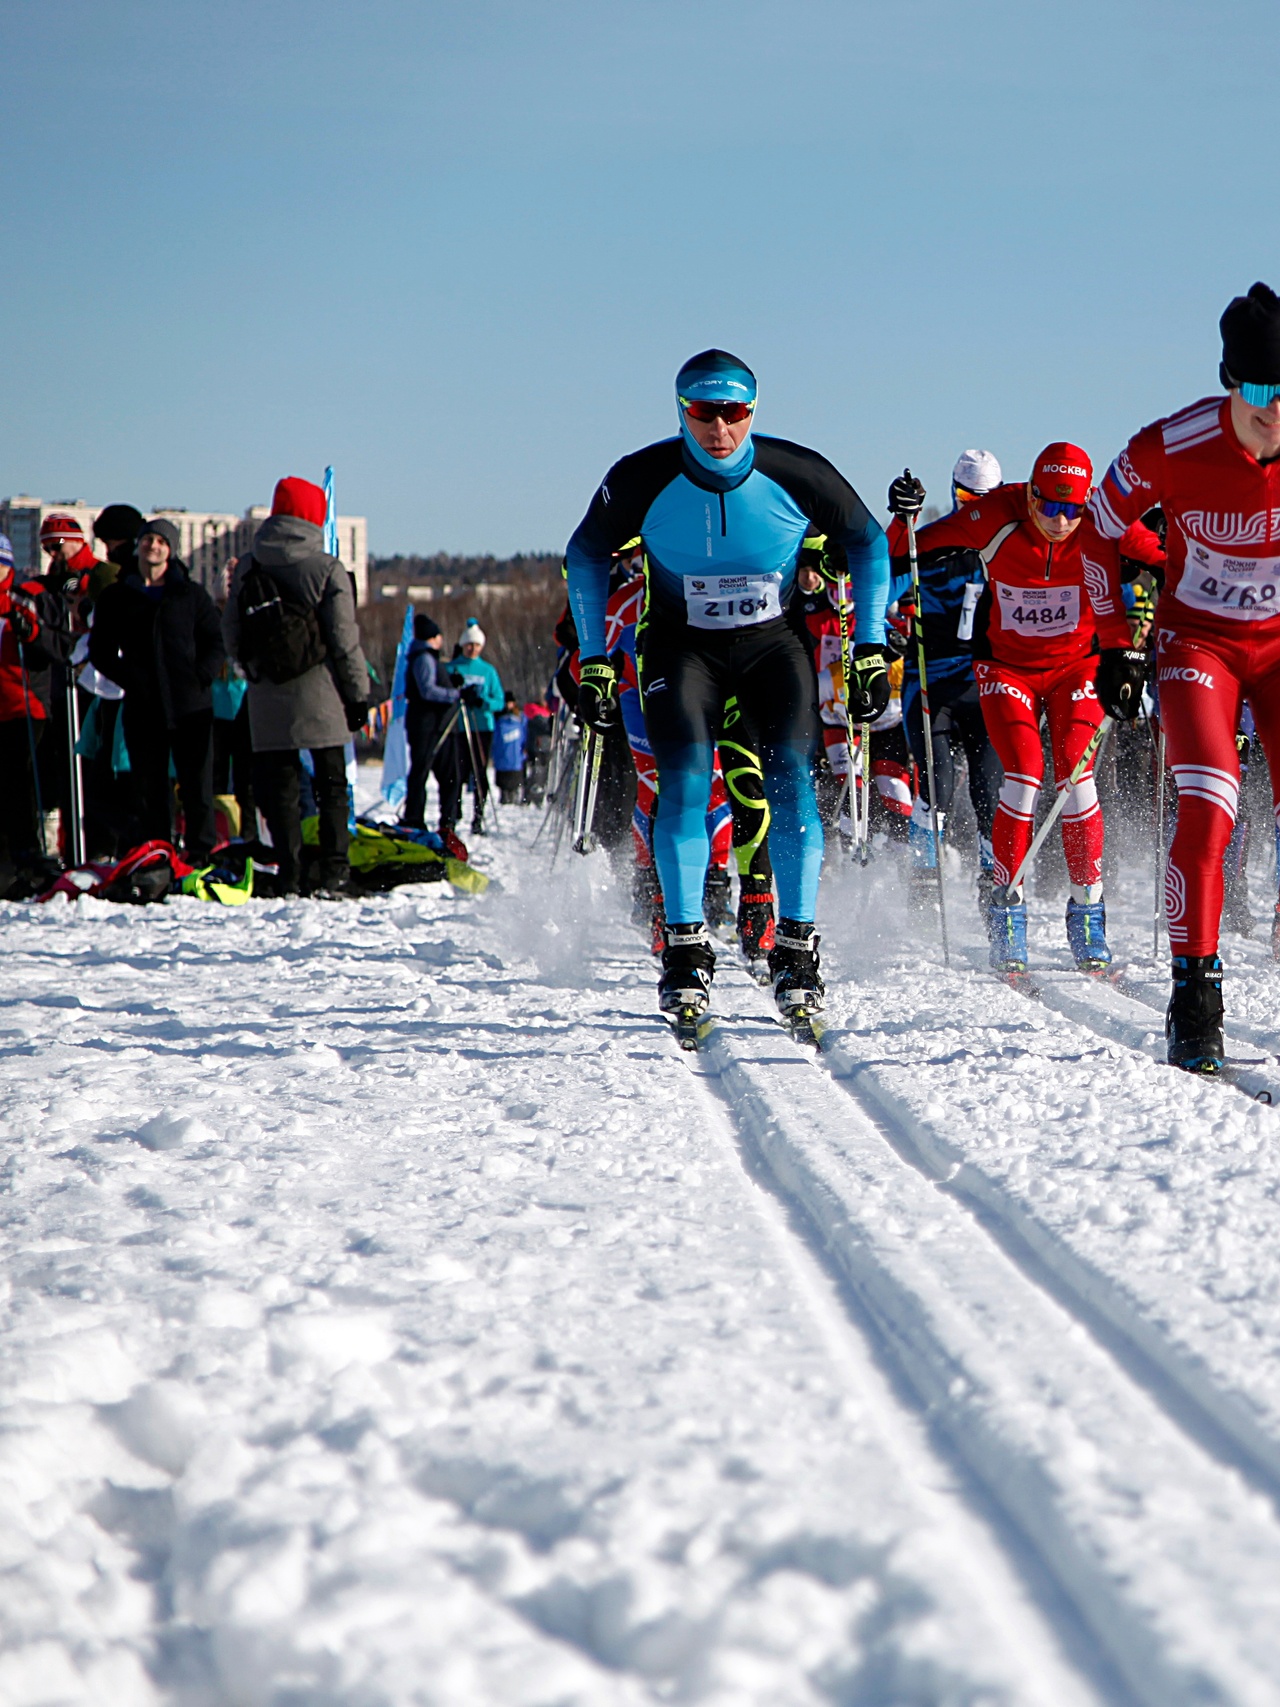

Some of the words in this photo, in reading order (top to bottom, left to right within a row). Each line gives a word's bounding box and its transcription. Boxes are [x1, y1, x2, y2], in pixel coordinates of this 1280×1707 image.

[1042, 464, 1087, 478] МОСКВА
[1222, 564, 1257, 573] РОССИИ
[1223, 559, 1257, 569] ЛЫЖНЯ
[718, 576, 748, 584] ЛЫЖНЯ
[1011, 605, 1068, 624] 4484
[1158, 667, 1214, 690] LUKOIL
[980, 682, 1032, 711] LUKOIL
[779, 937, 809, 948] salomon
